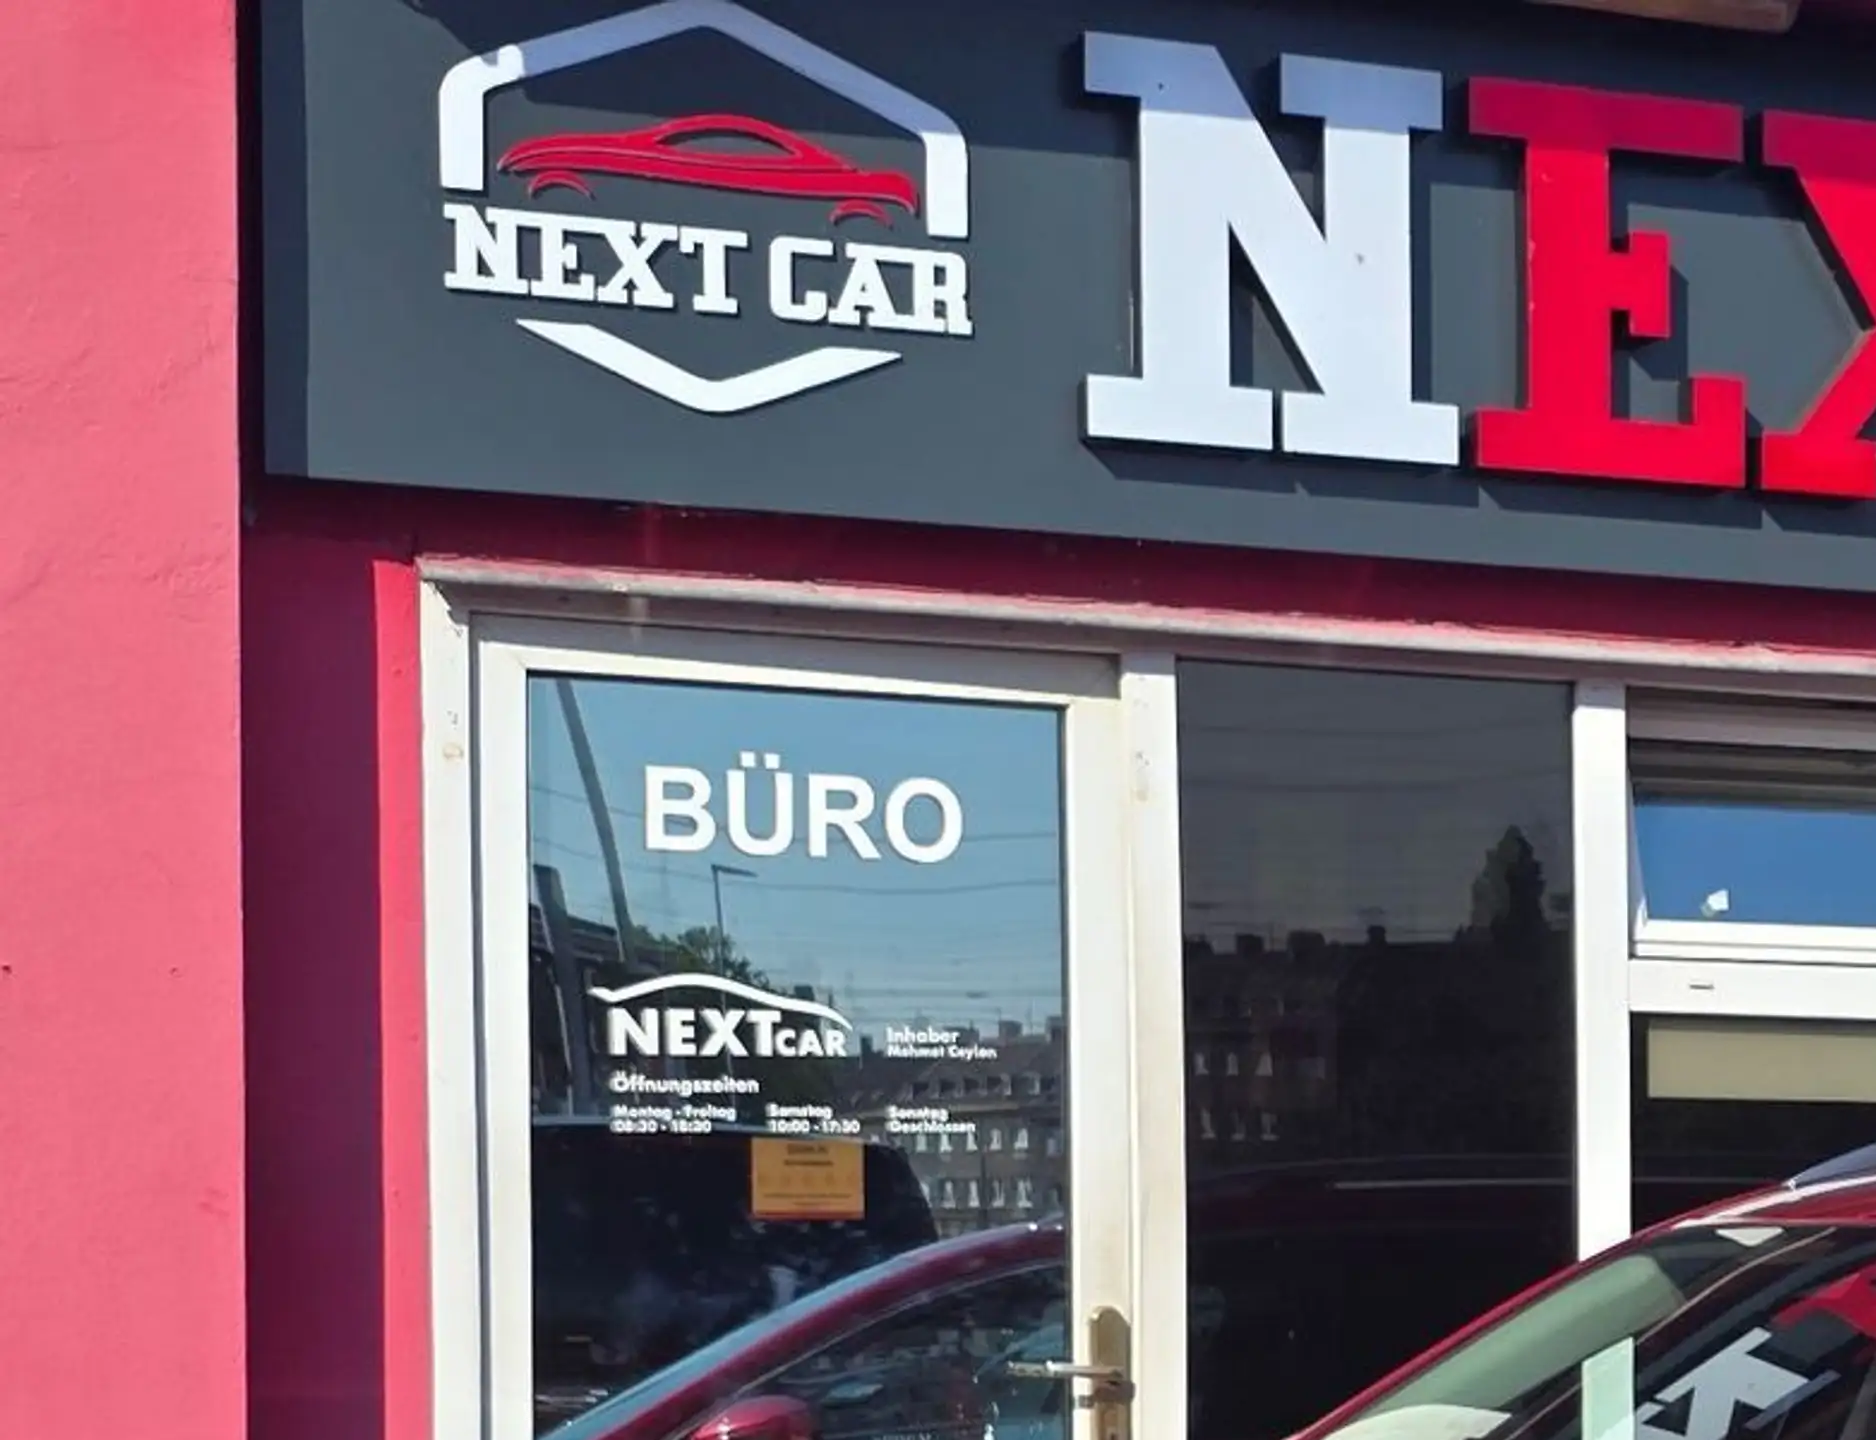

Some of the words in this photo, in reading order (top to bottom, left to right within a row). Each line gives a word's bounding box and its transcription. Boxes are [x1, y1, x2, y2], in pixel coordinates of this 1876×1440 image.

[444, 204, 748, 315] NEXT
[769, 236, 974, 336] CAR
[645, 751, 963, 864] BÜRO
[886, 1026, 960, 1044] Inhaber
[610, 1070, 760, 1097] Öffnungszeiten
[612, 1104, 672, 1121] Montag
[681, 1103, 737, 1121] Freitag
[765, 1103, 833, 1120] Samstag
